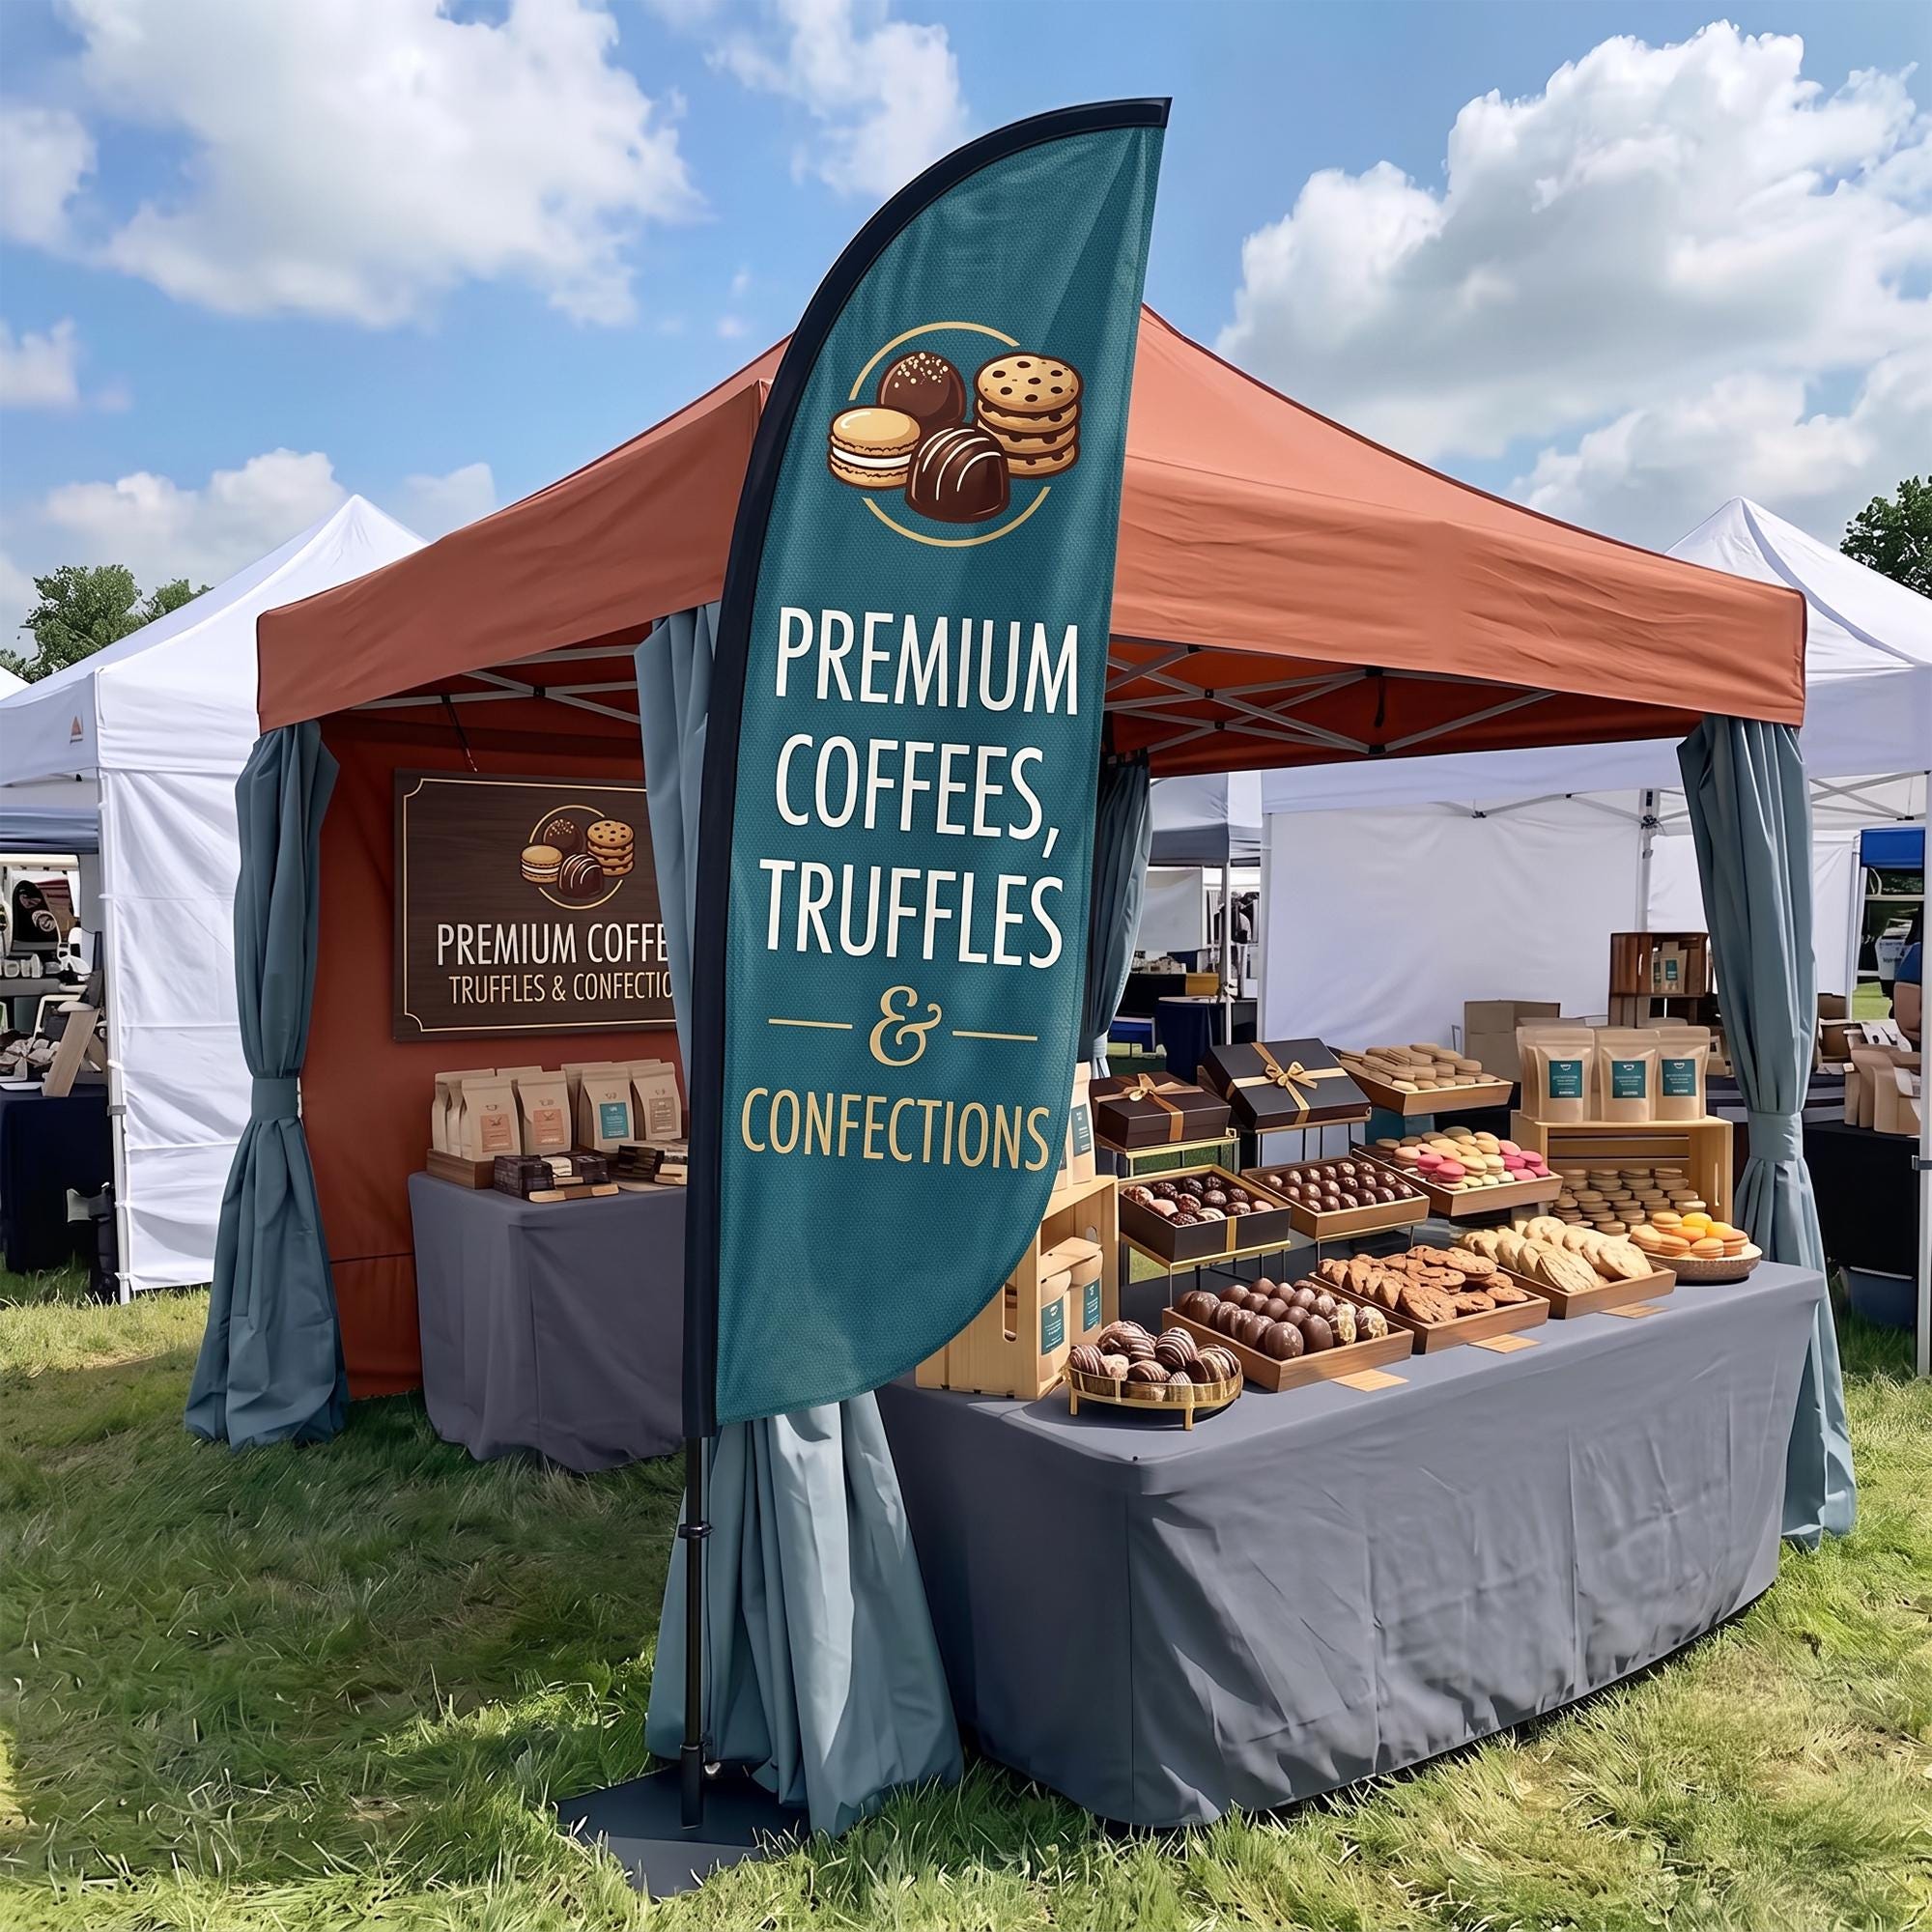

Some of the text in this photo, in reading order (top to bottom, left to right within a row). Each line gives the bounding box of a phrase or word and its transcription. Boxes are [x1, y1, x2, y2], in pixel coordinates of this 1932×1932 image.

[776, 607, 1078, 716] PREMIUM
[776, 733, 1060, 859] COFFEES,
[438, 923, 668, 966] PREMIUM COFFE
[759, 858, 1064, 969] TRUFFLES
[448, 971, 673, 1005] TRUFFLES & CONFECTIO
[869, 985, 943, 1066] &
[741, 1087, 1050, 1172] CONFECTIONS
